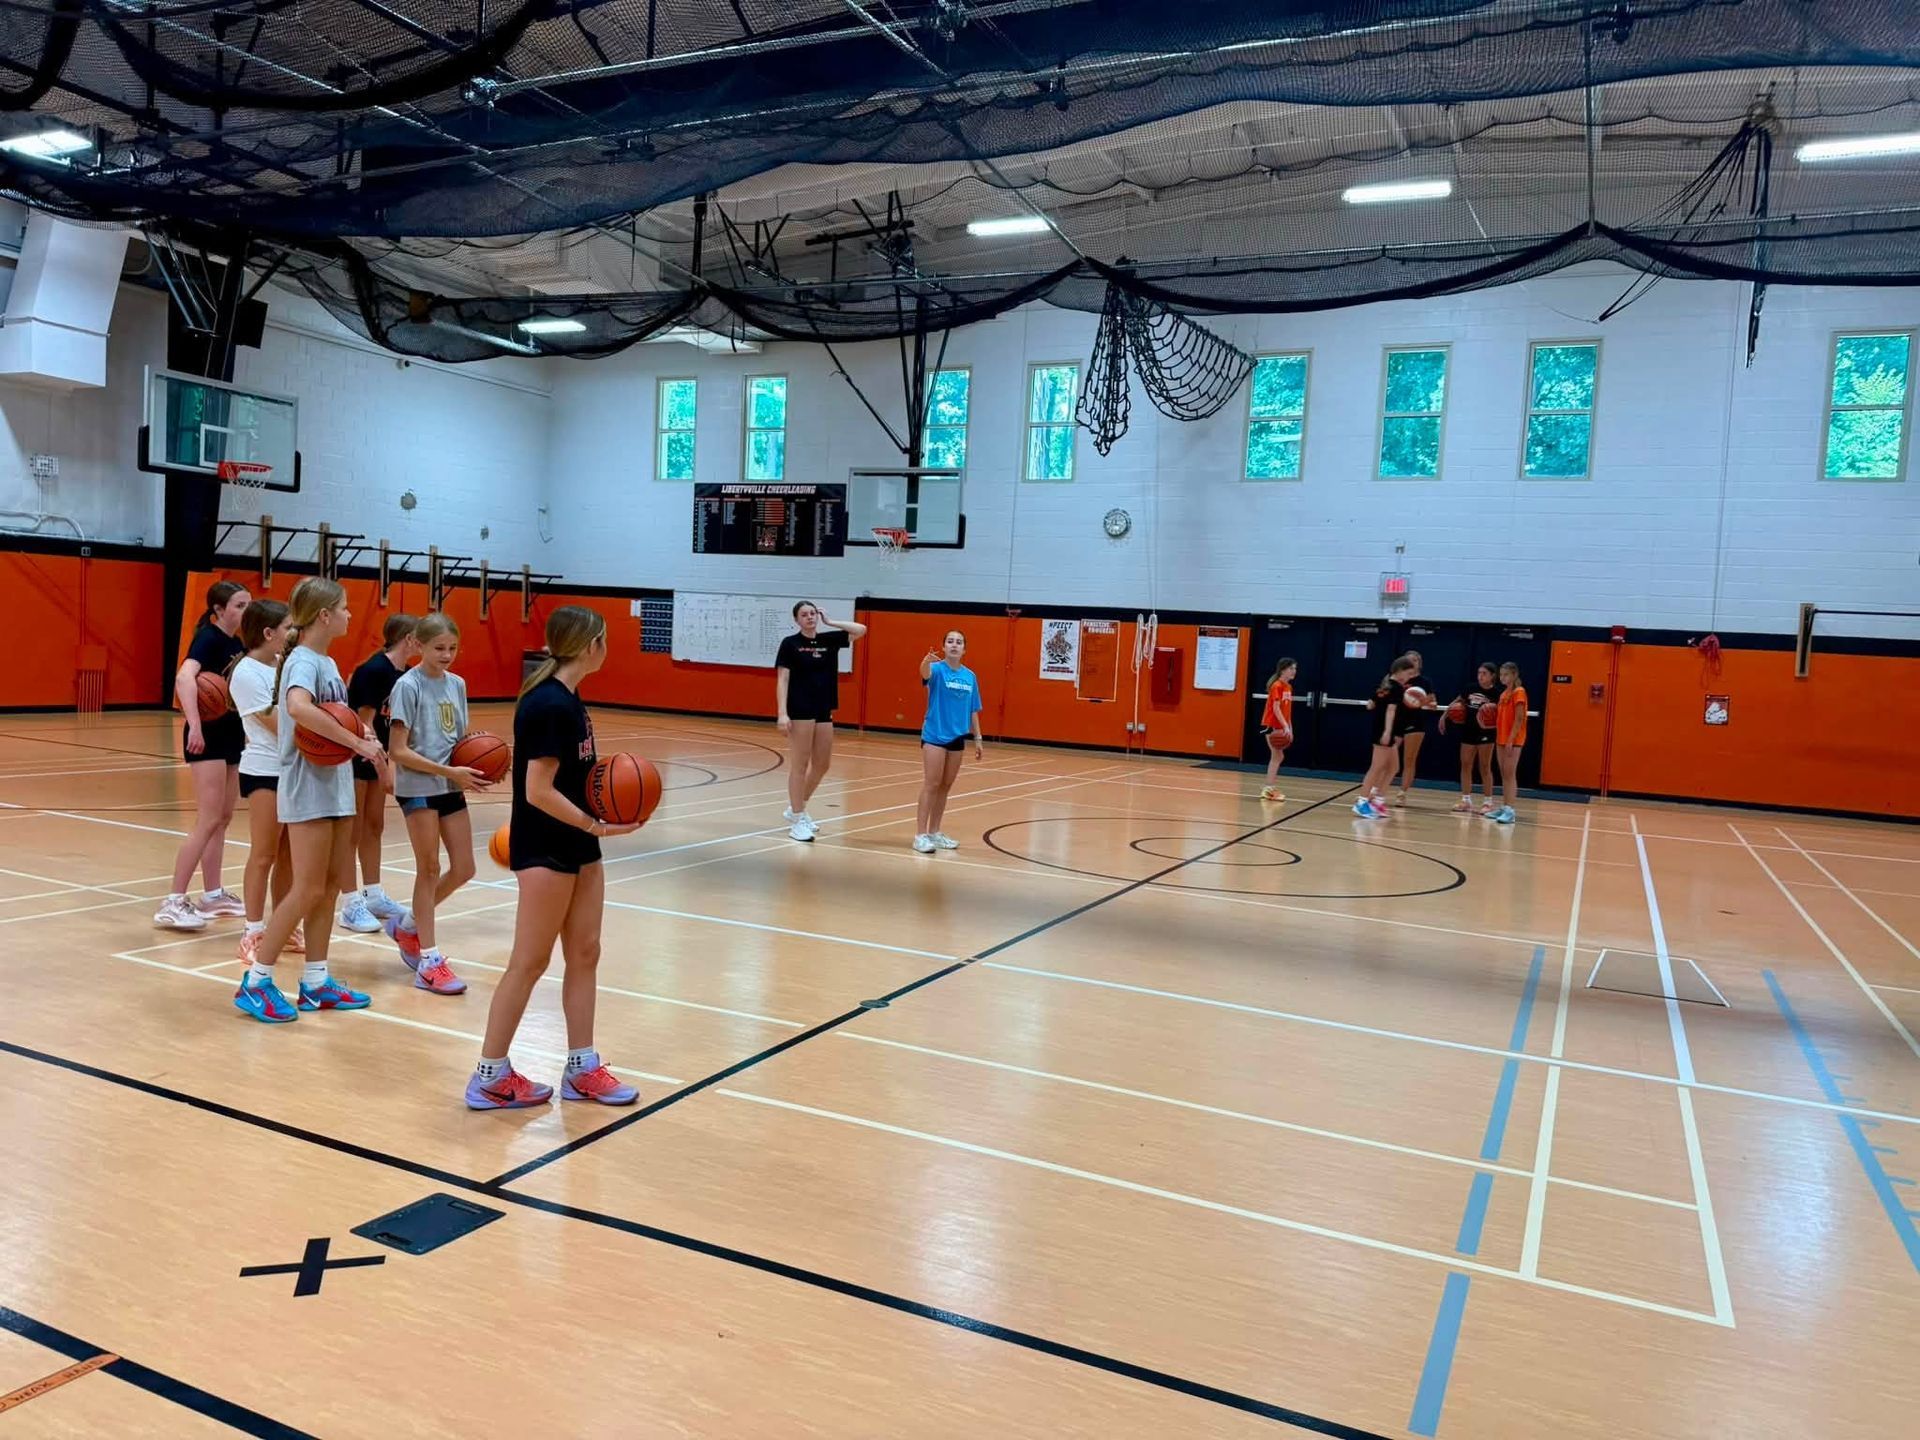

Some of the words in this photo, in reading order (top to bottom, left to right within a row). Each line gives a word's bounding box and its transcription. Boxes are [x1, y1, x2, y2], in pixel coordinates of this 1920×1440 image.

[721, 484, 766, 494] LIBERTYVILLE
[766, 485, 816, 495] CHEERLEADING
[592, 763, 608, 816] Wilson
